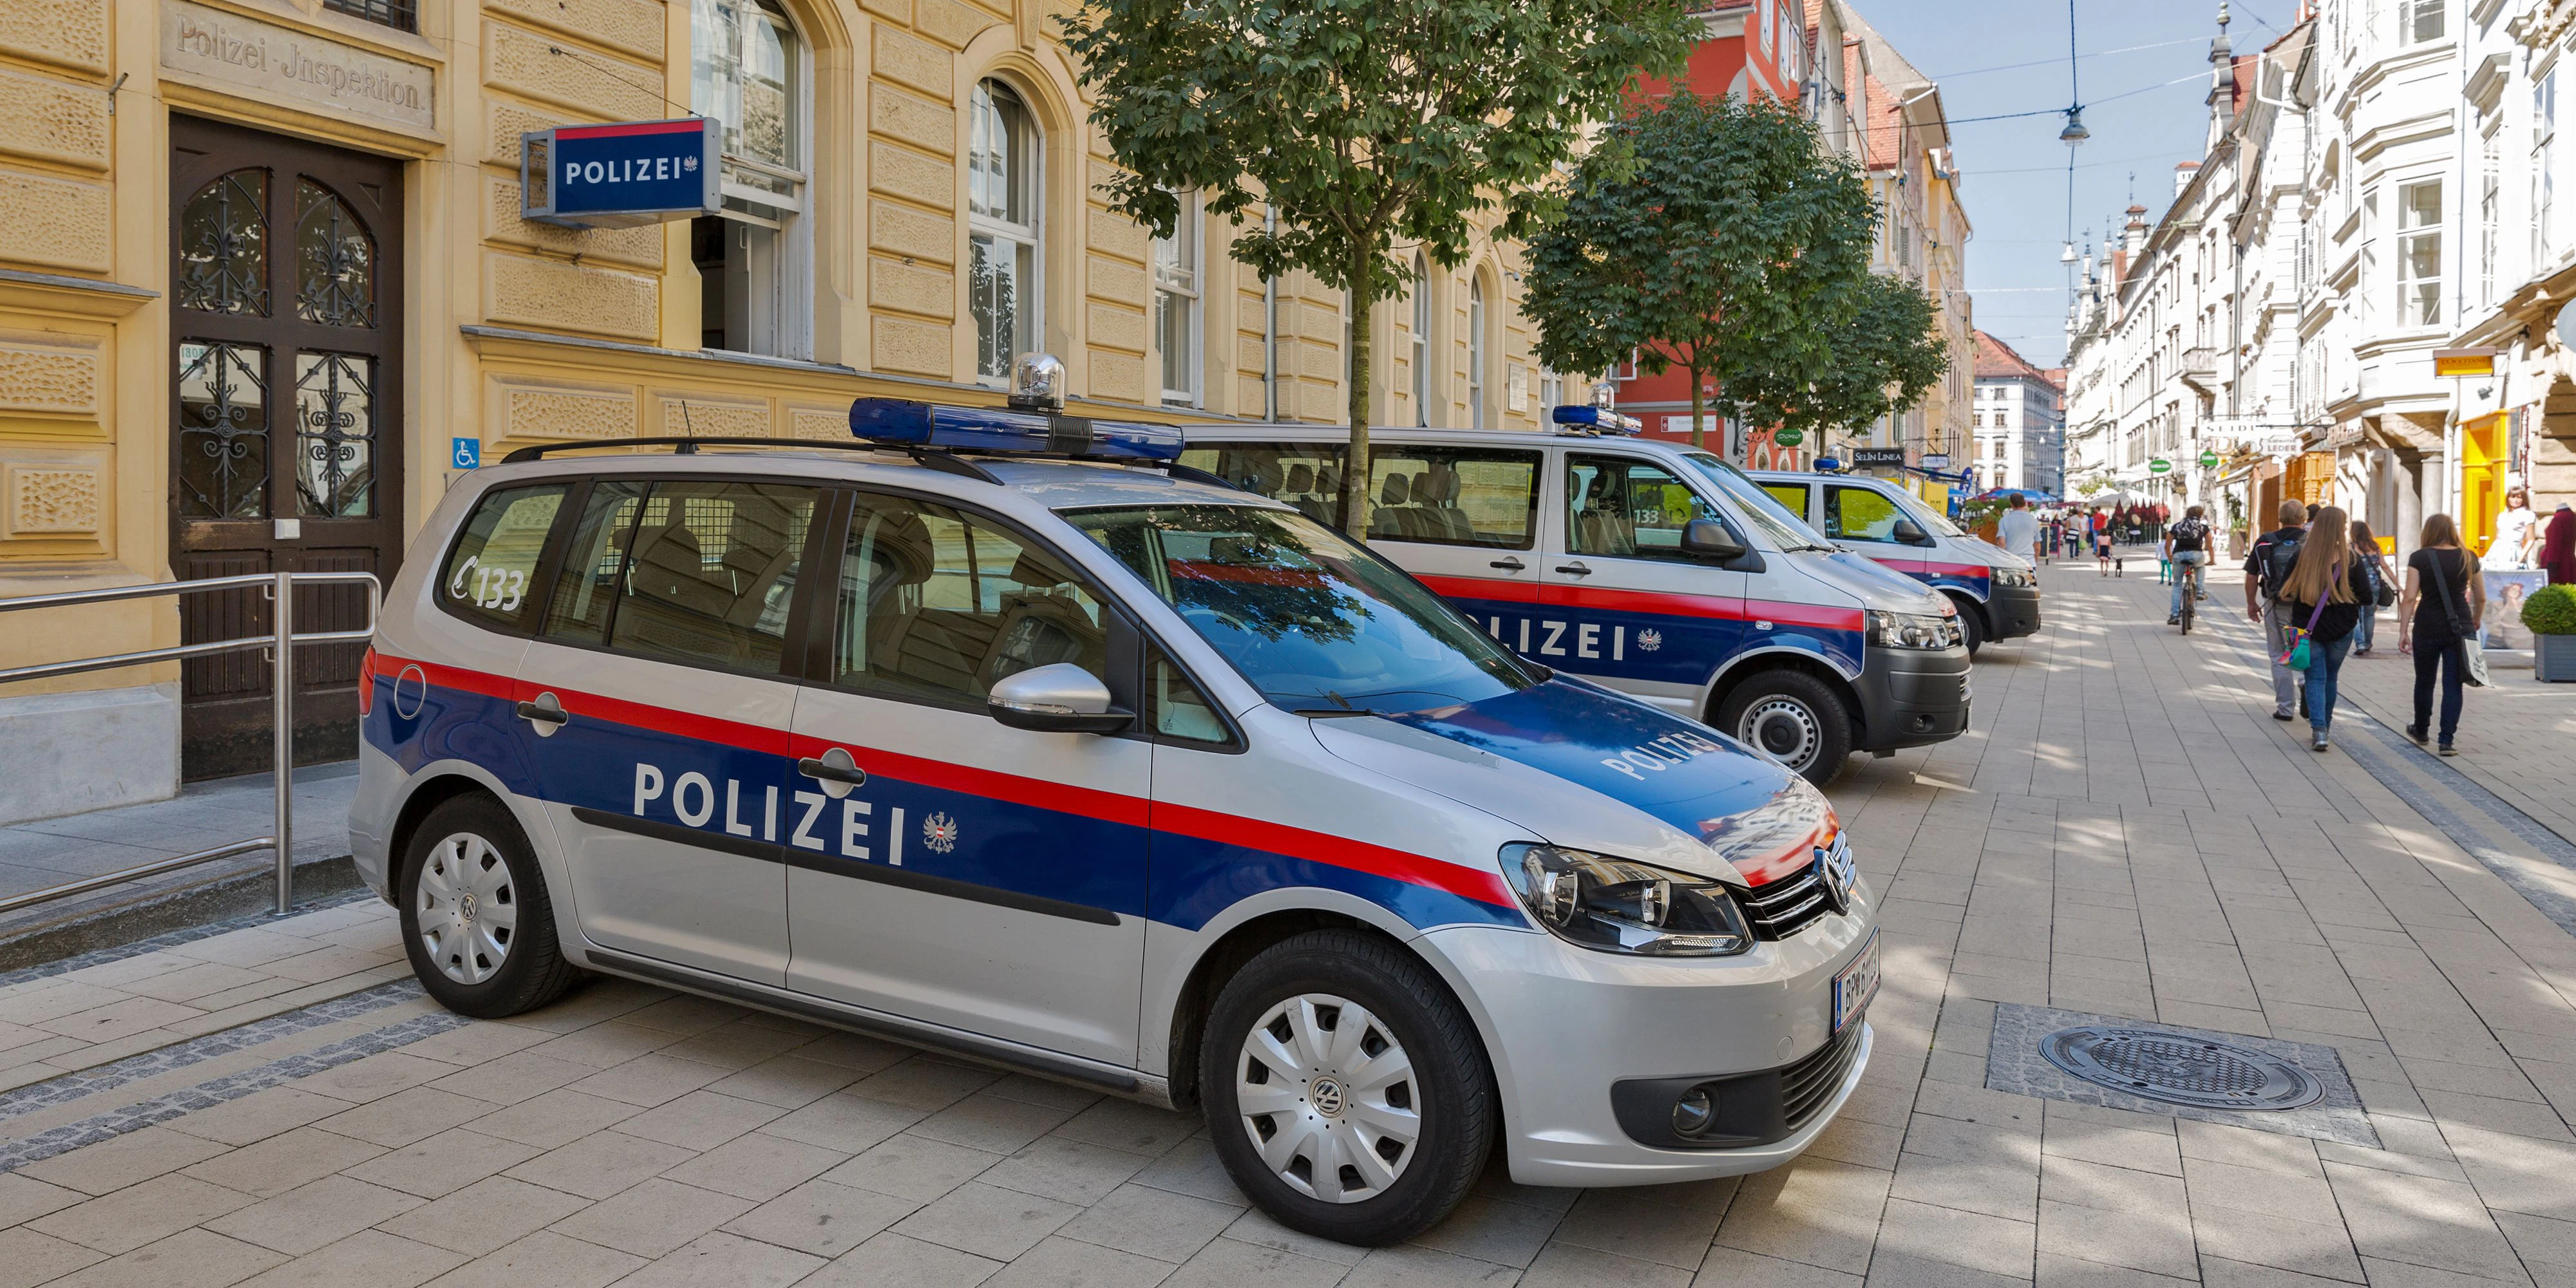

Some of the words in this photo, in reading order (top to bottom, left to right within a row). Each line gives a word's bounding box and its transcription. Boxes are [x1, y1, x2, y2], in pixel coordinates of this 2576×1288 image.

[566, 156, 680, 185] POLIZEI
[1877, 452, 1902, 461] LINEA
[1634, 509, 1660, 524] 133
[475, 567, 525, 612] 133
[1600, 731, 1723, 781] POLIZEI
[634, 762, 904, 866] POLIZEI
